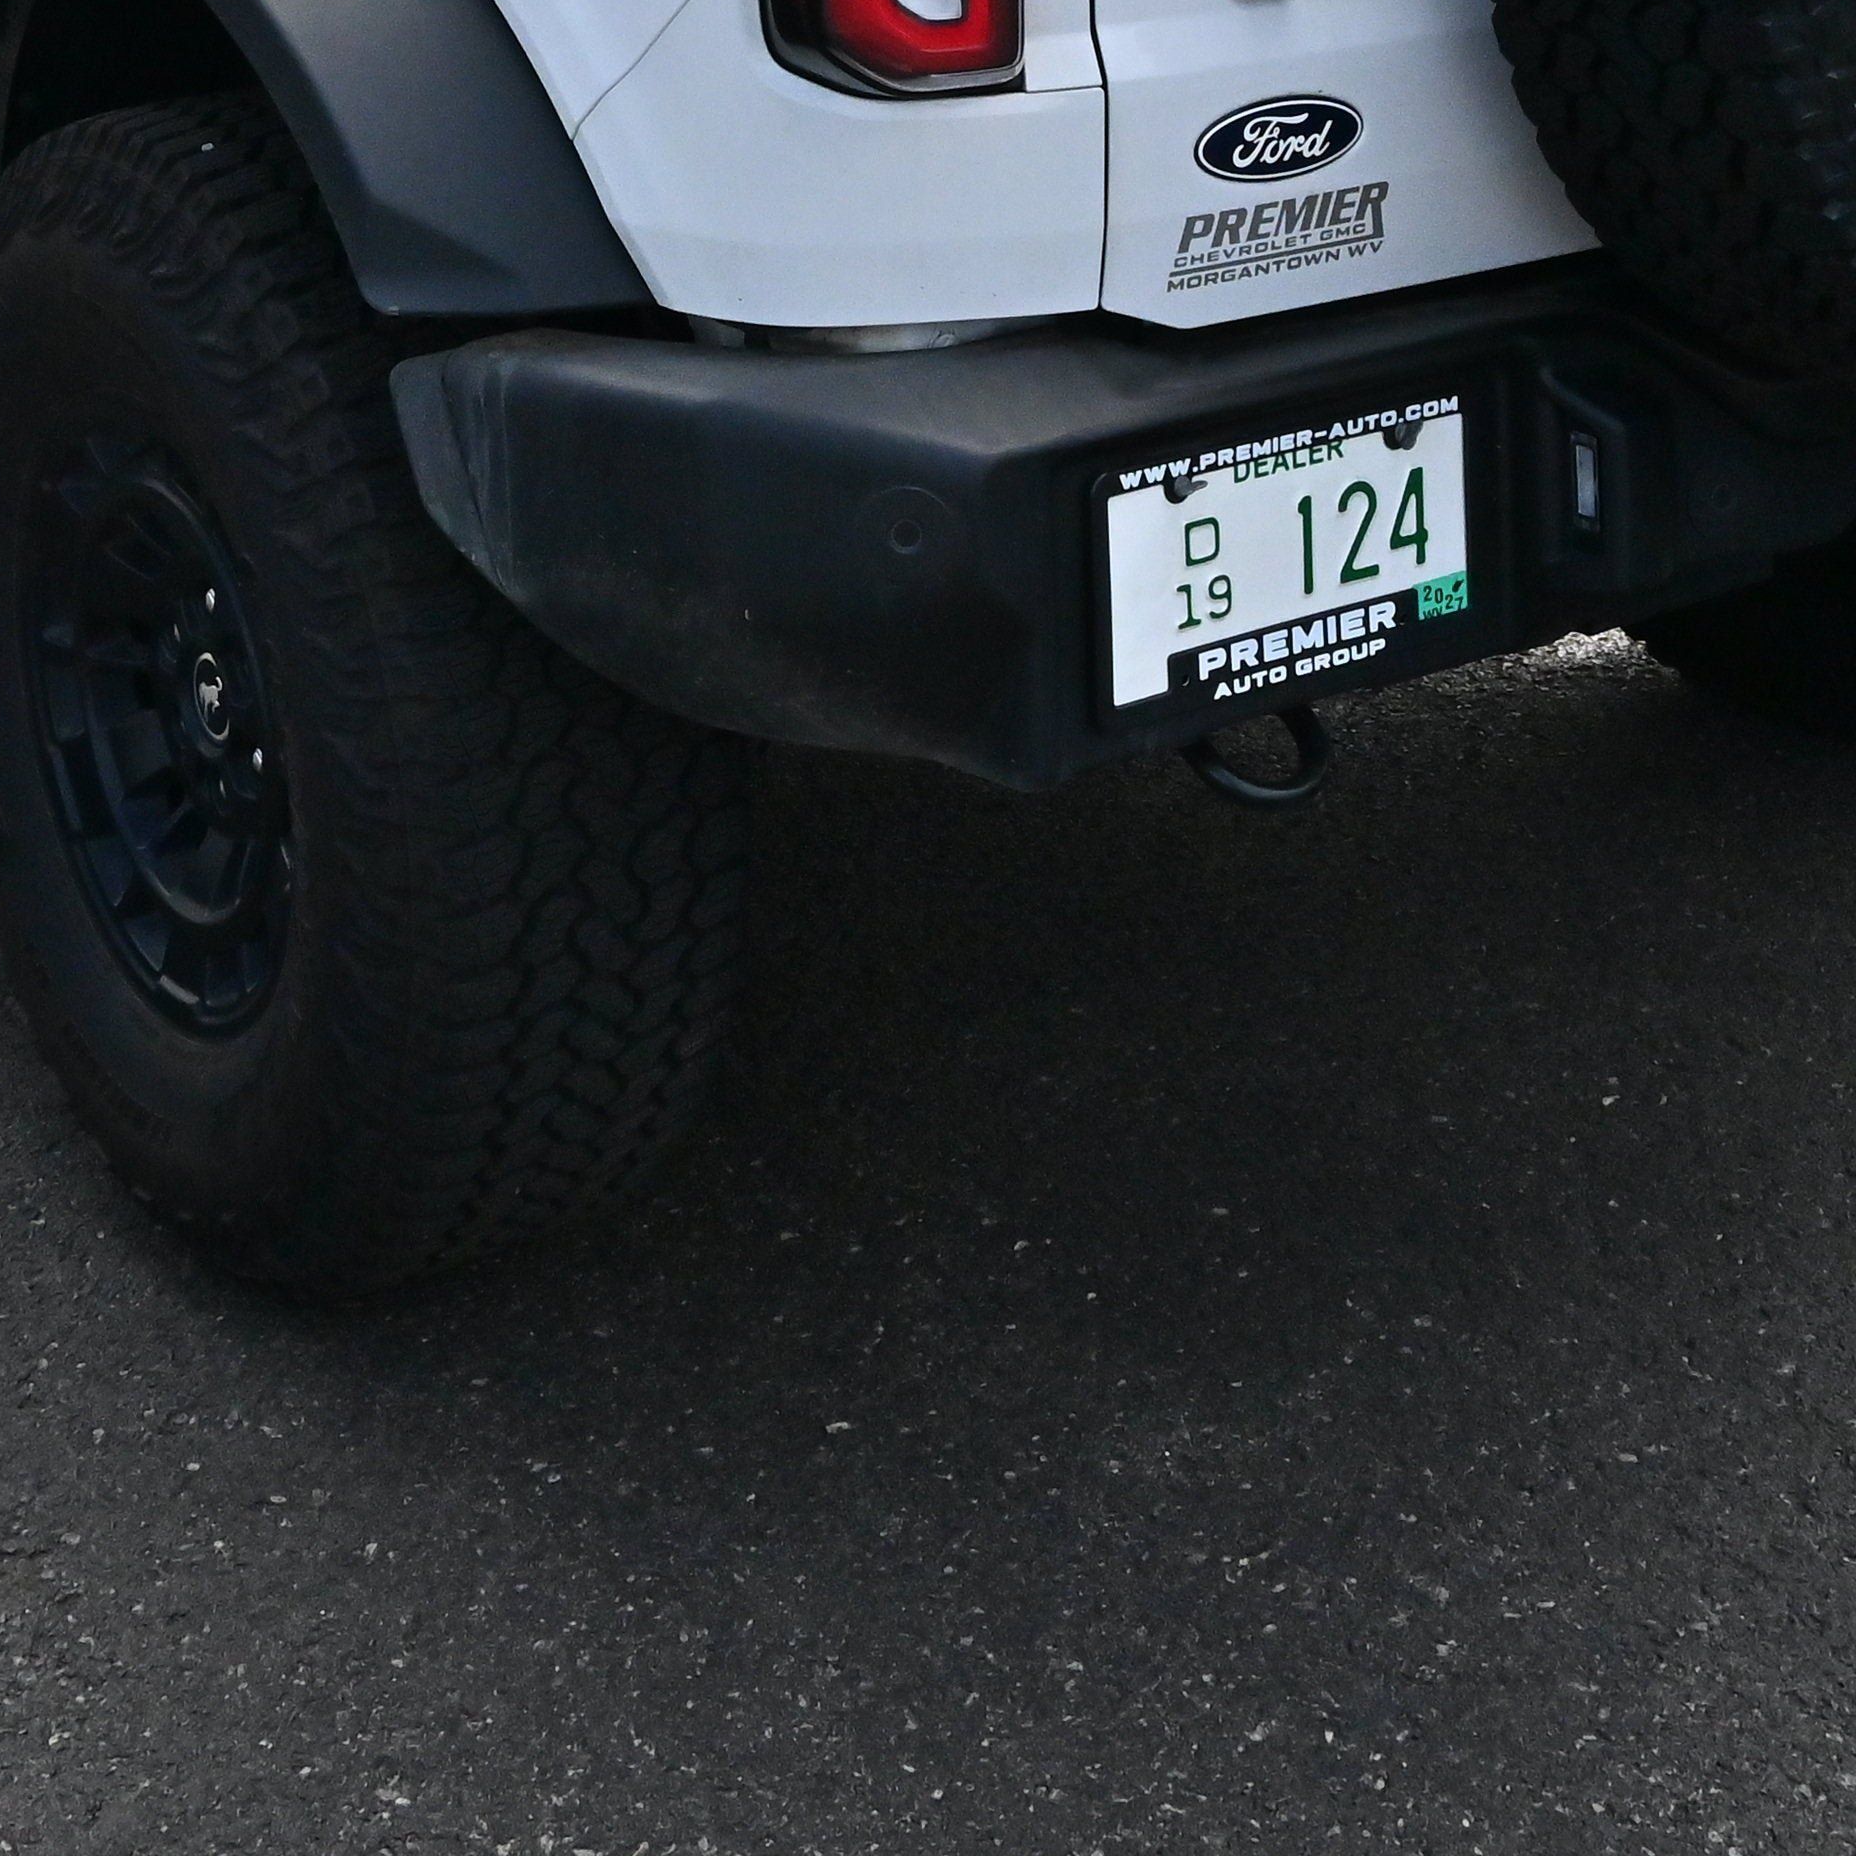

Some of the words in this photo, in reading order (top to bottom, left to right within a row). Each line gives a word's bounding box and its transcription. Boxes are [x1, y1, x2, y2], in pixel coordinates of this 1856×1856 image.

[1232, 112, 1333, 168] Ford
[1174, 234, 1312, 268] CHEVROLET
[1319, 223, 1366, 241] GMC
[1177, 181, 1390, 254] PREMIER
[1167, 248, 1341, 293] MORGANTOWN
[1347, 241, 1384, 258] WV
[1118, 395, 1460, 491] WWW.PREMIER-AUTO.COM
[1233, 440, 1344, 484] DEALER
[1184, 516, 1221, 567] D
[1297, 466, 1429, 595] 124
[1176, 574, 1233, 630] 19
[1423, 585, 1464, 612] 2027
[1197, 600, 1396, 682] PREMIER
[1213, 665, 1287, 701] AUTO
[1294, 638, 1387, 678] GROUP
